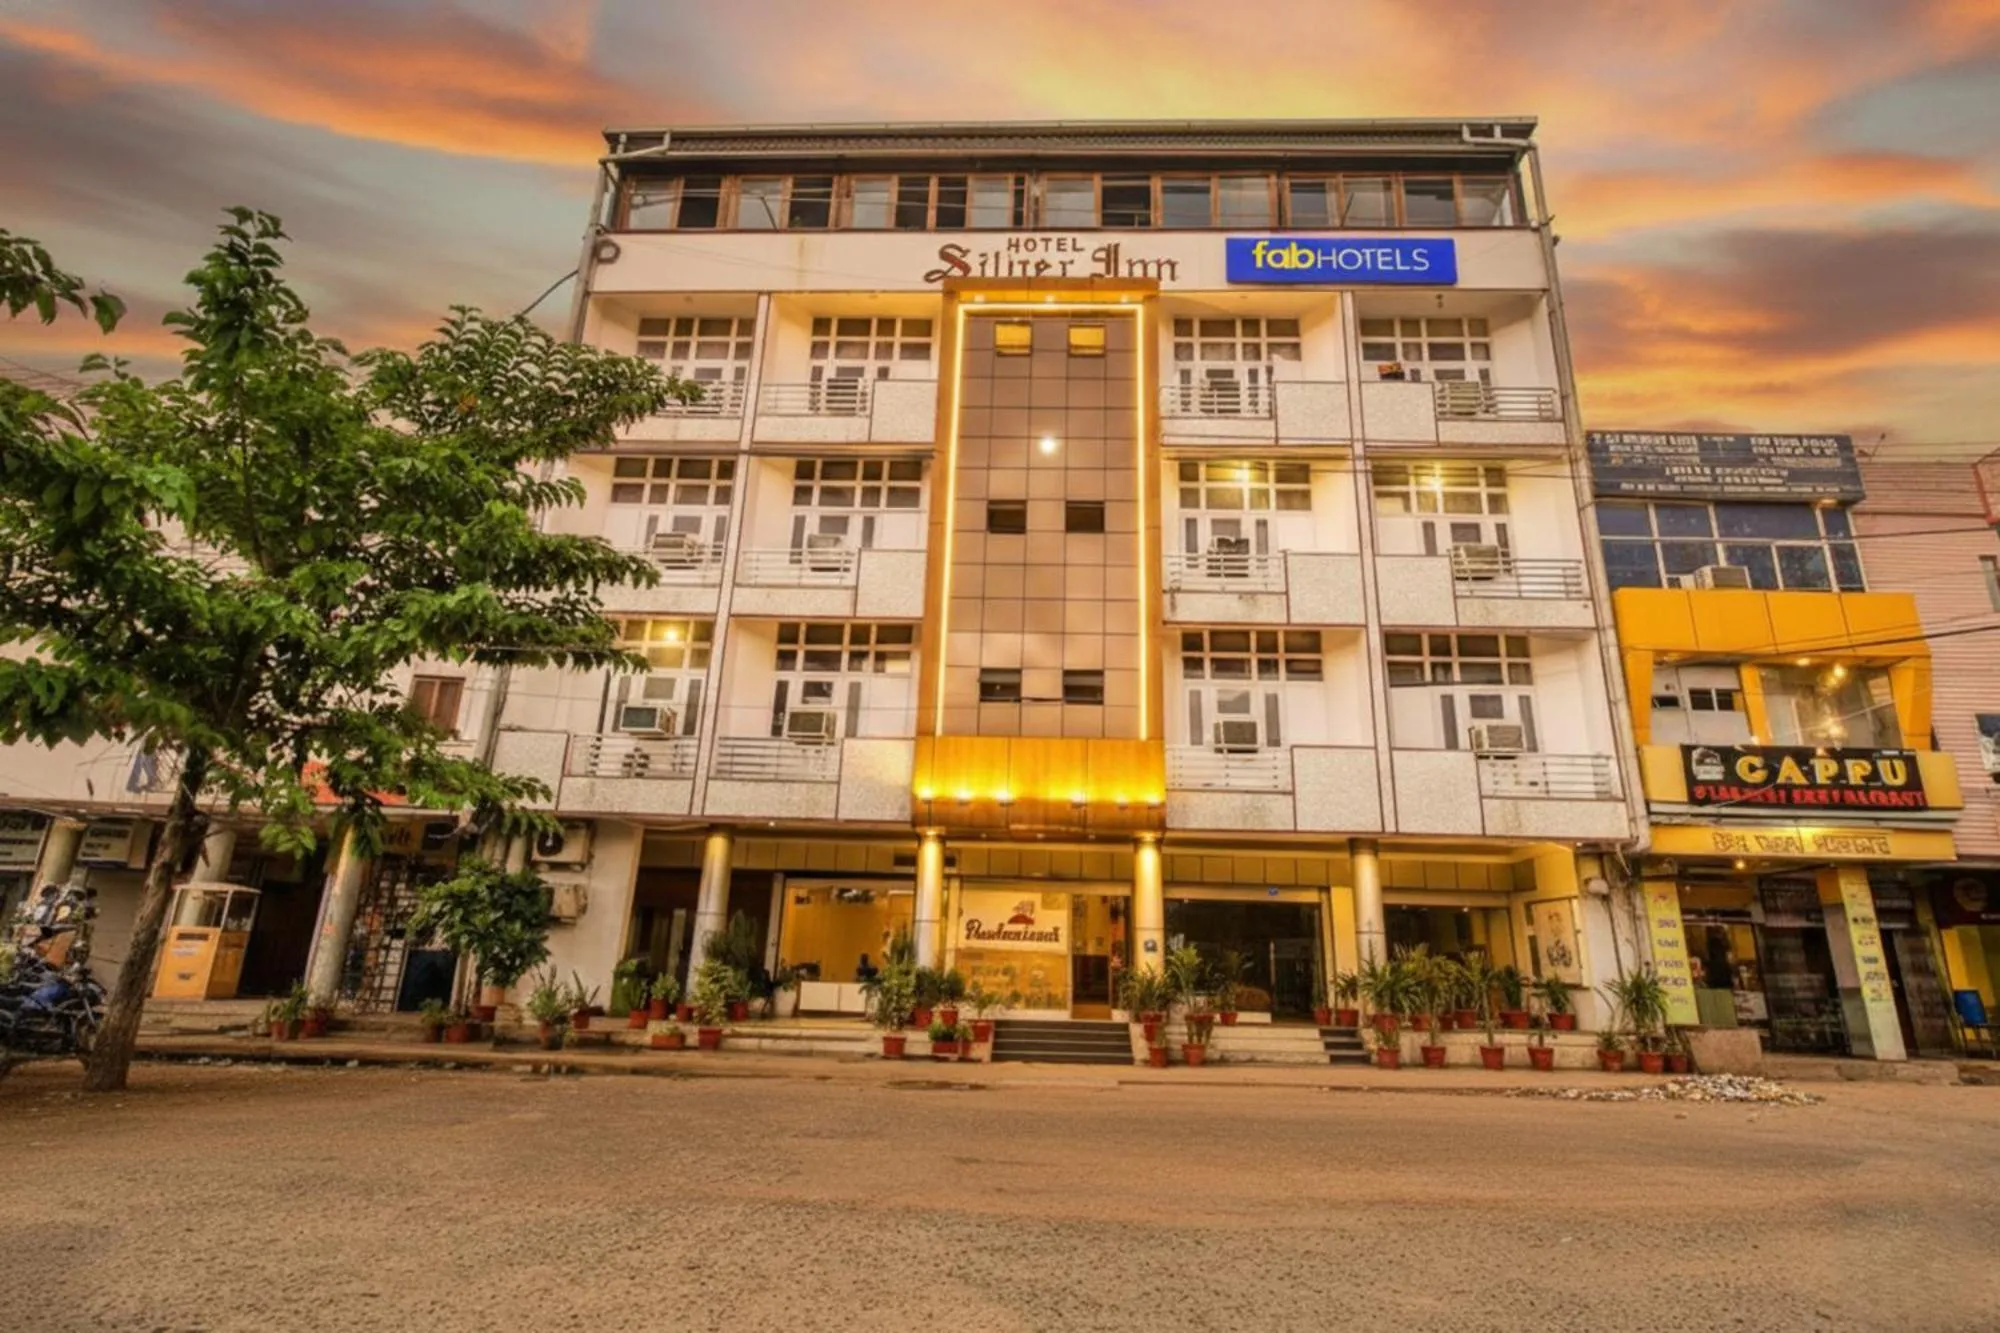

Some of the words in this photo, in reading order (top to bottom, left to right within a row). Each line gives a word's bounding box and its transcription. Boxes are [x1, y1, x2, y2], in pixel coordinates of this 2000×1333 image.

[1006, 237, 1085, 253] HOTEL
[1252, 240, 1430, 271] fabHOTELS
[1090, 242, 1179, 282] Inn
[1735, 755, 1907, 787] CAPPU
